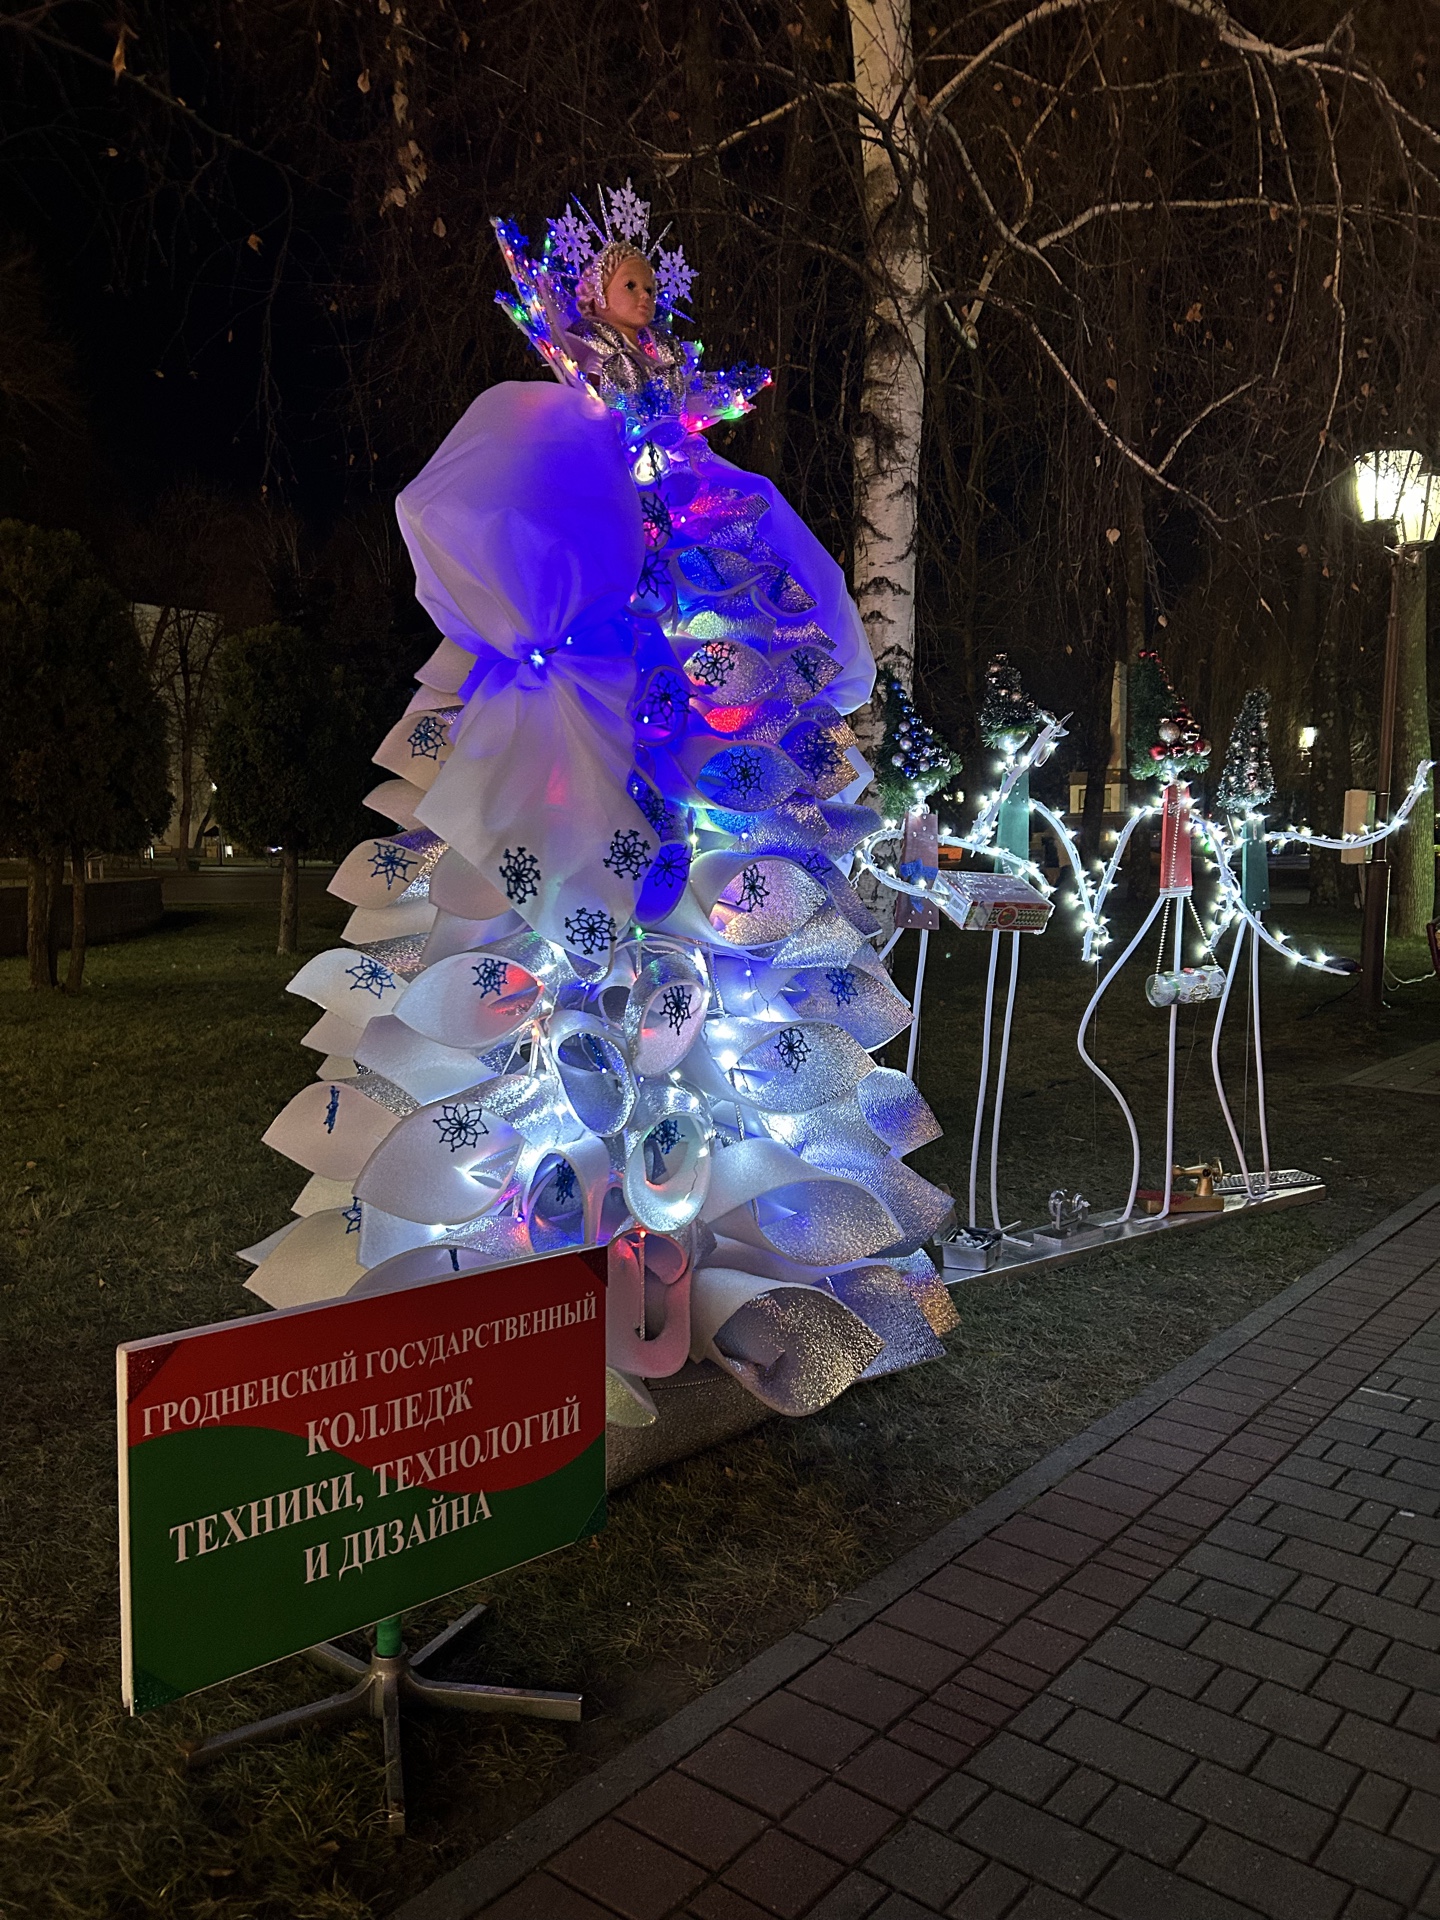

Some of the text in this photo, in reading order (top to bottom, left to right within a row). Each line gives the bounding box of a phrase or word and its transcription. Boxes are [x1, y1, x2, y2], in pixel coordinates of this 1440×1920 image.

[142, 1292, 597, 1437] ГРОДНЕНСКИЙ ГОСУДАРСТВЕННЫЙ
[305, 1377, 474, 1457] КОЛЛЕДЖ
[169, 1395, 582, 1564] ТЕХНИКИ, ТЕХНОЛОГИЙ
[303, 1489, 493, 1585] И ДИЗАЙНА
